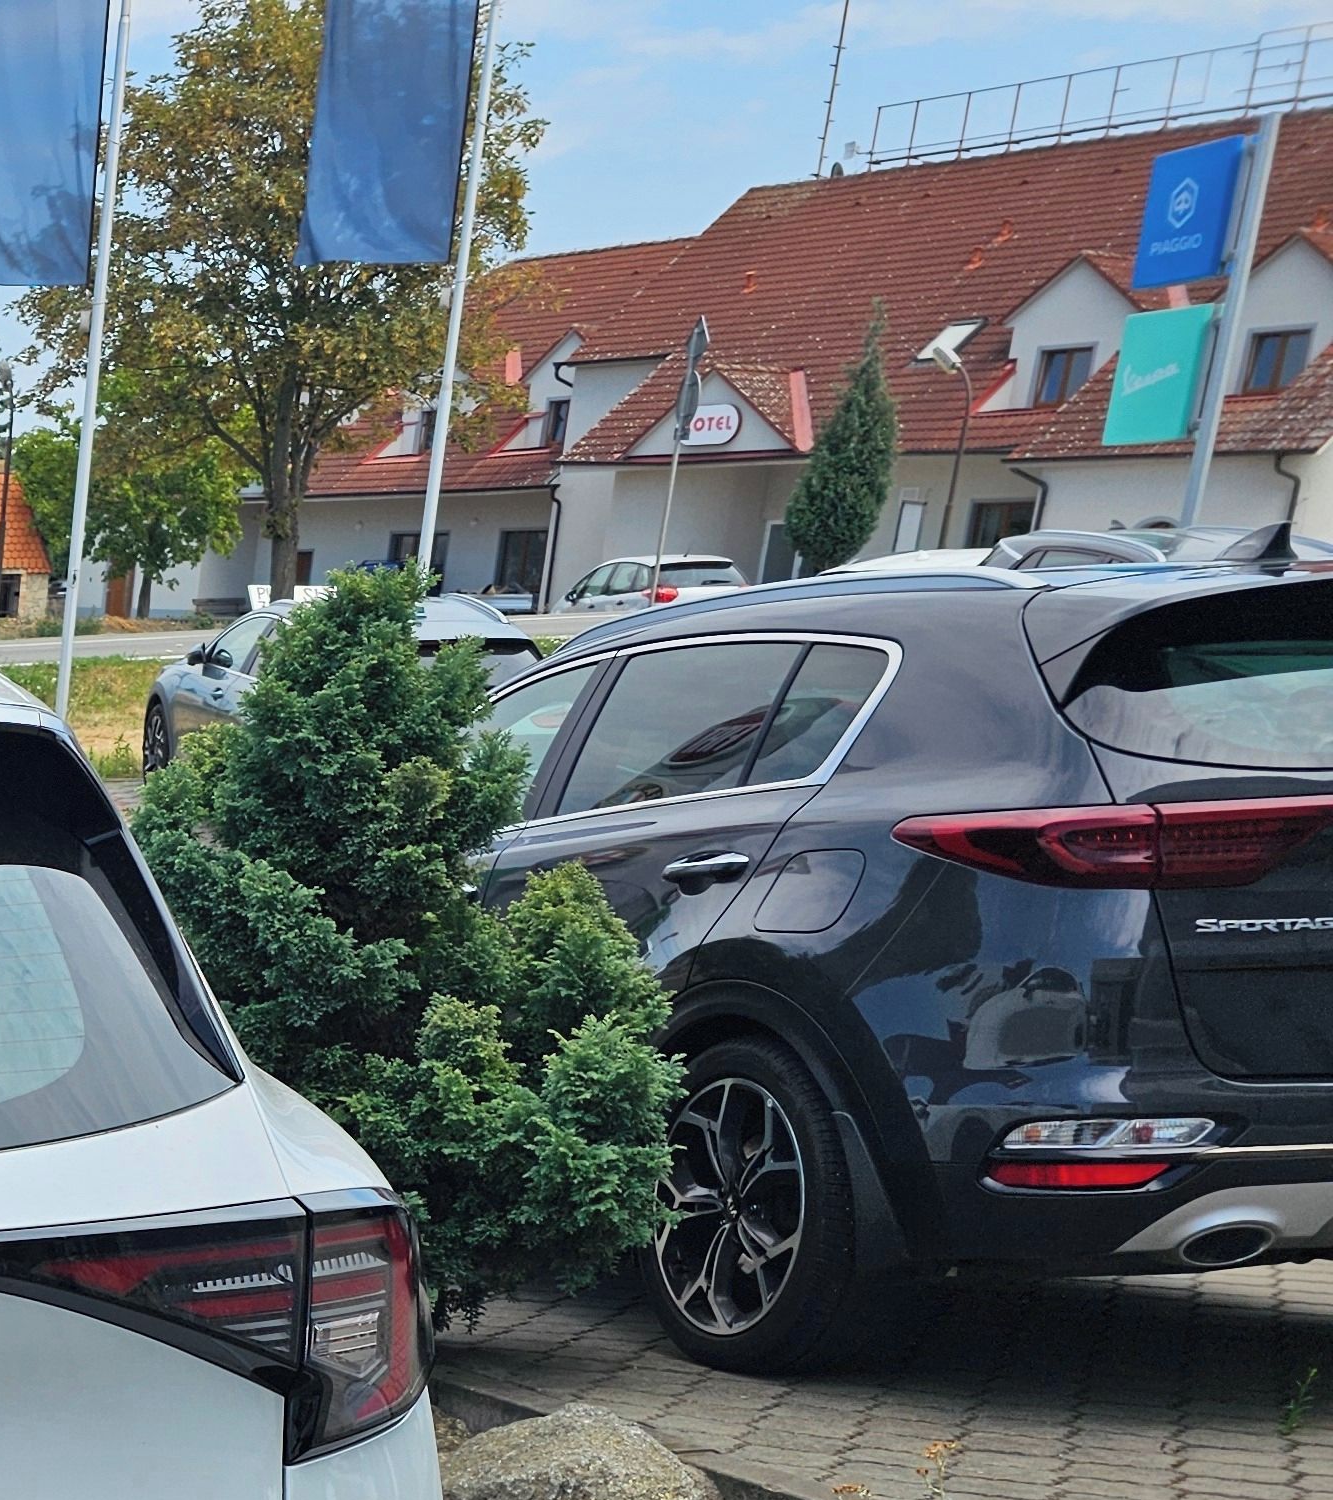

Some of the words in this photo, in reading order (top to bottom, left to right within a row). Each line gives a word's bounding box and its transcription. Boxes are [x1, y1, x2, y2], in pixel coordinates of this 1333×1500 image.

[1149, 233, 1203, 256] PIAGGIO
[691, 415, 732, 432] OTEL
[1195, 917, 1333, 933] SPORTAG
